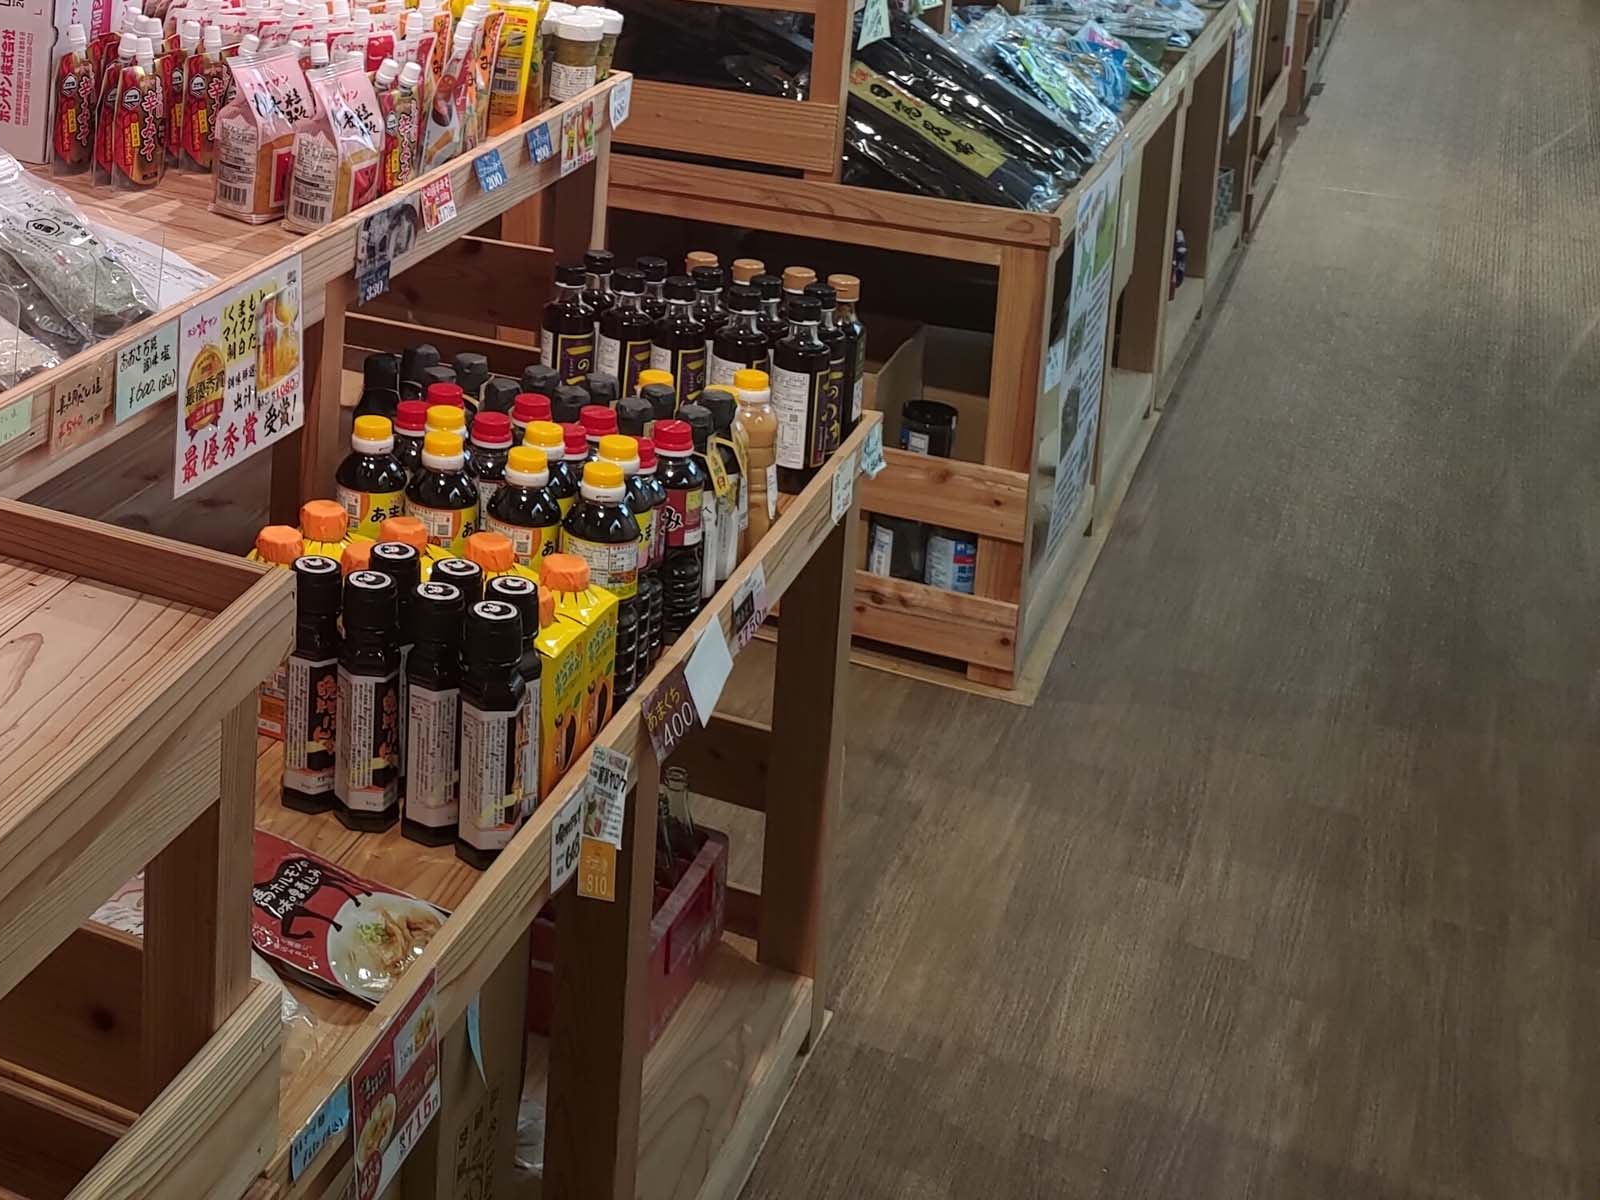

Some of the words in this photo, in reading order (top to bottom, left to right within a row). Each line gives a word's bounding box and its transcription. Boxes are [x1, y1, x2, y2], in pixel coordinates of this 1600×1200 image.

[77, 76, 92, 146] 辛みそ
[140, 90, 156, 162] 辛みそ
[485, 172, 503, 190] 200
[365, 282, 385, 300] 330
[182, 412, 260, 485] 最優秀賞
[646, 687, 681, 733] あまくち
[663, 701, 694, 748] 400
[276, 868, 323, 915] 味噌煮込み
